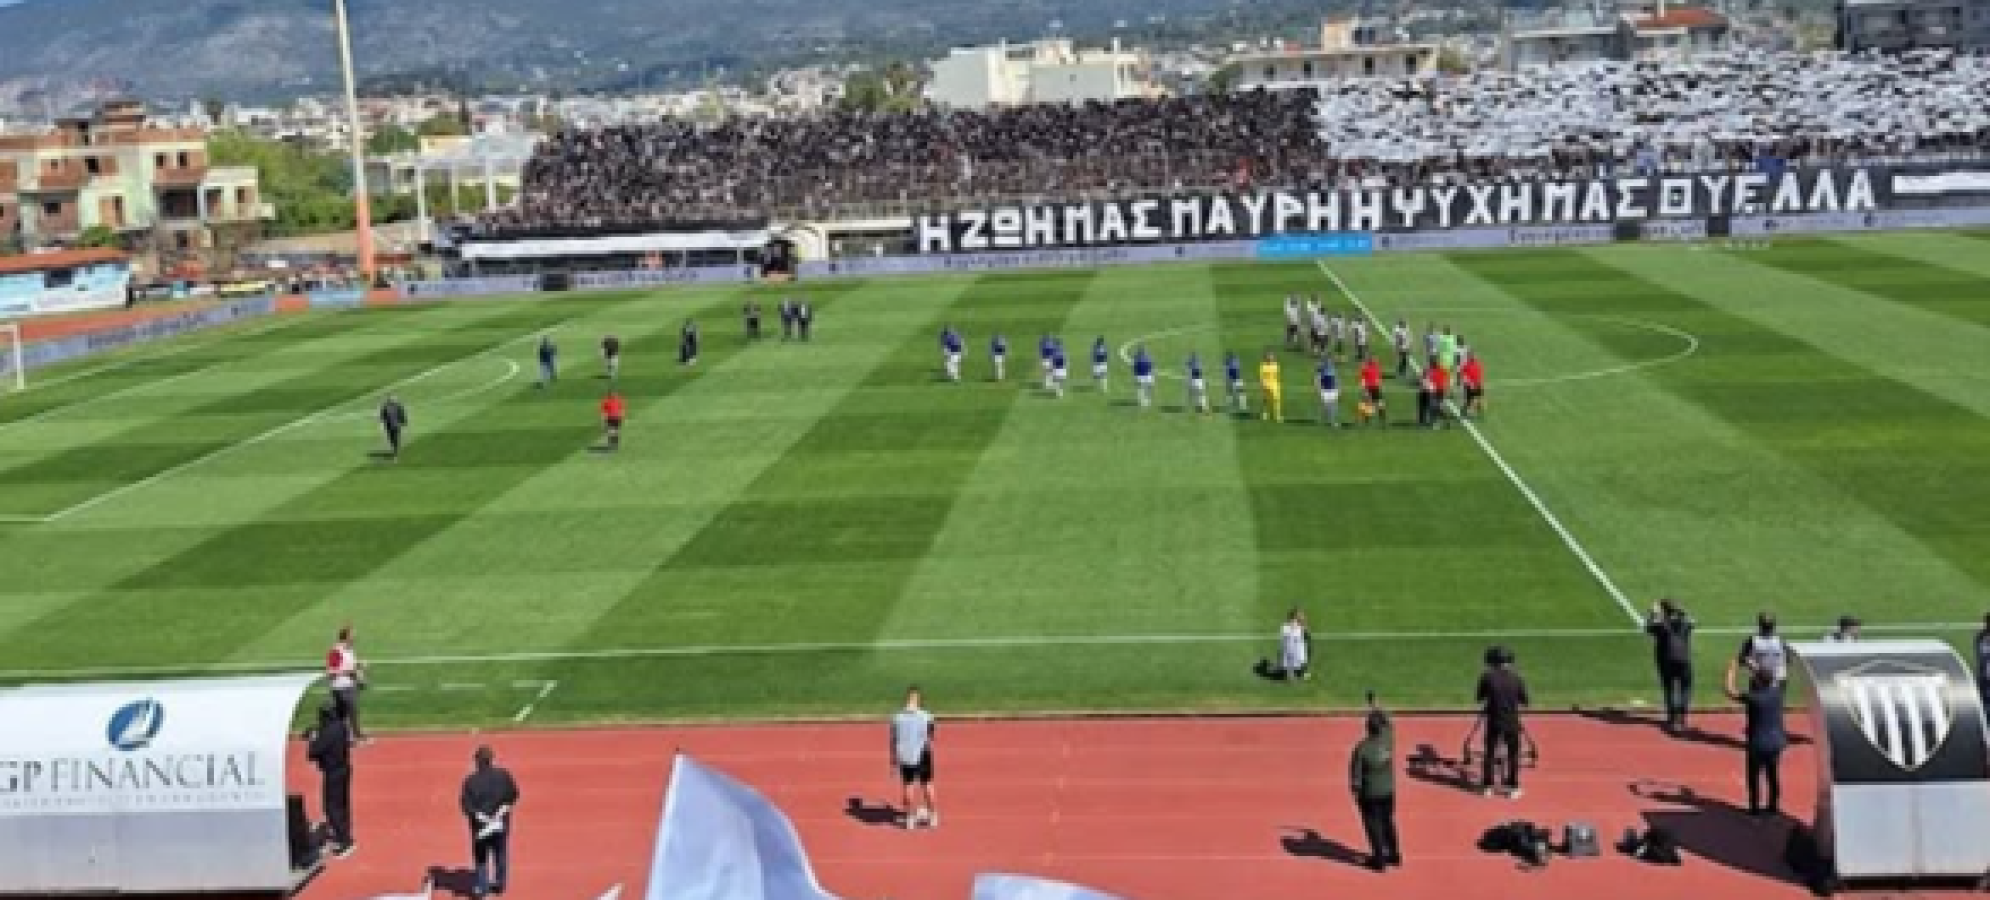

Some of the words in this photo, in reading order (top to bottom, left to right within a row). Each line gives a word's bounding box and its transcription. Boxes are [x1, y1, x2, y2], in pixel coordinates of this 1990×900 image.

[920, 215, 949, 251] Η
[1065, 198, 1162, 242] ΜΑΣ
[1541, 178, 1647, 221] ΜΑΣ
[51, 751, 266, 790] FINANCIAL
